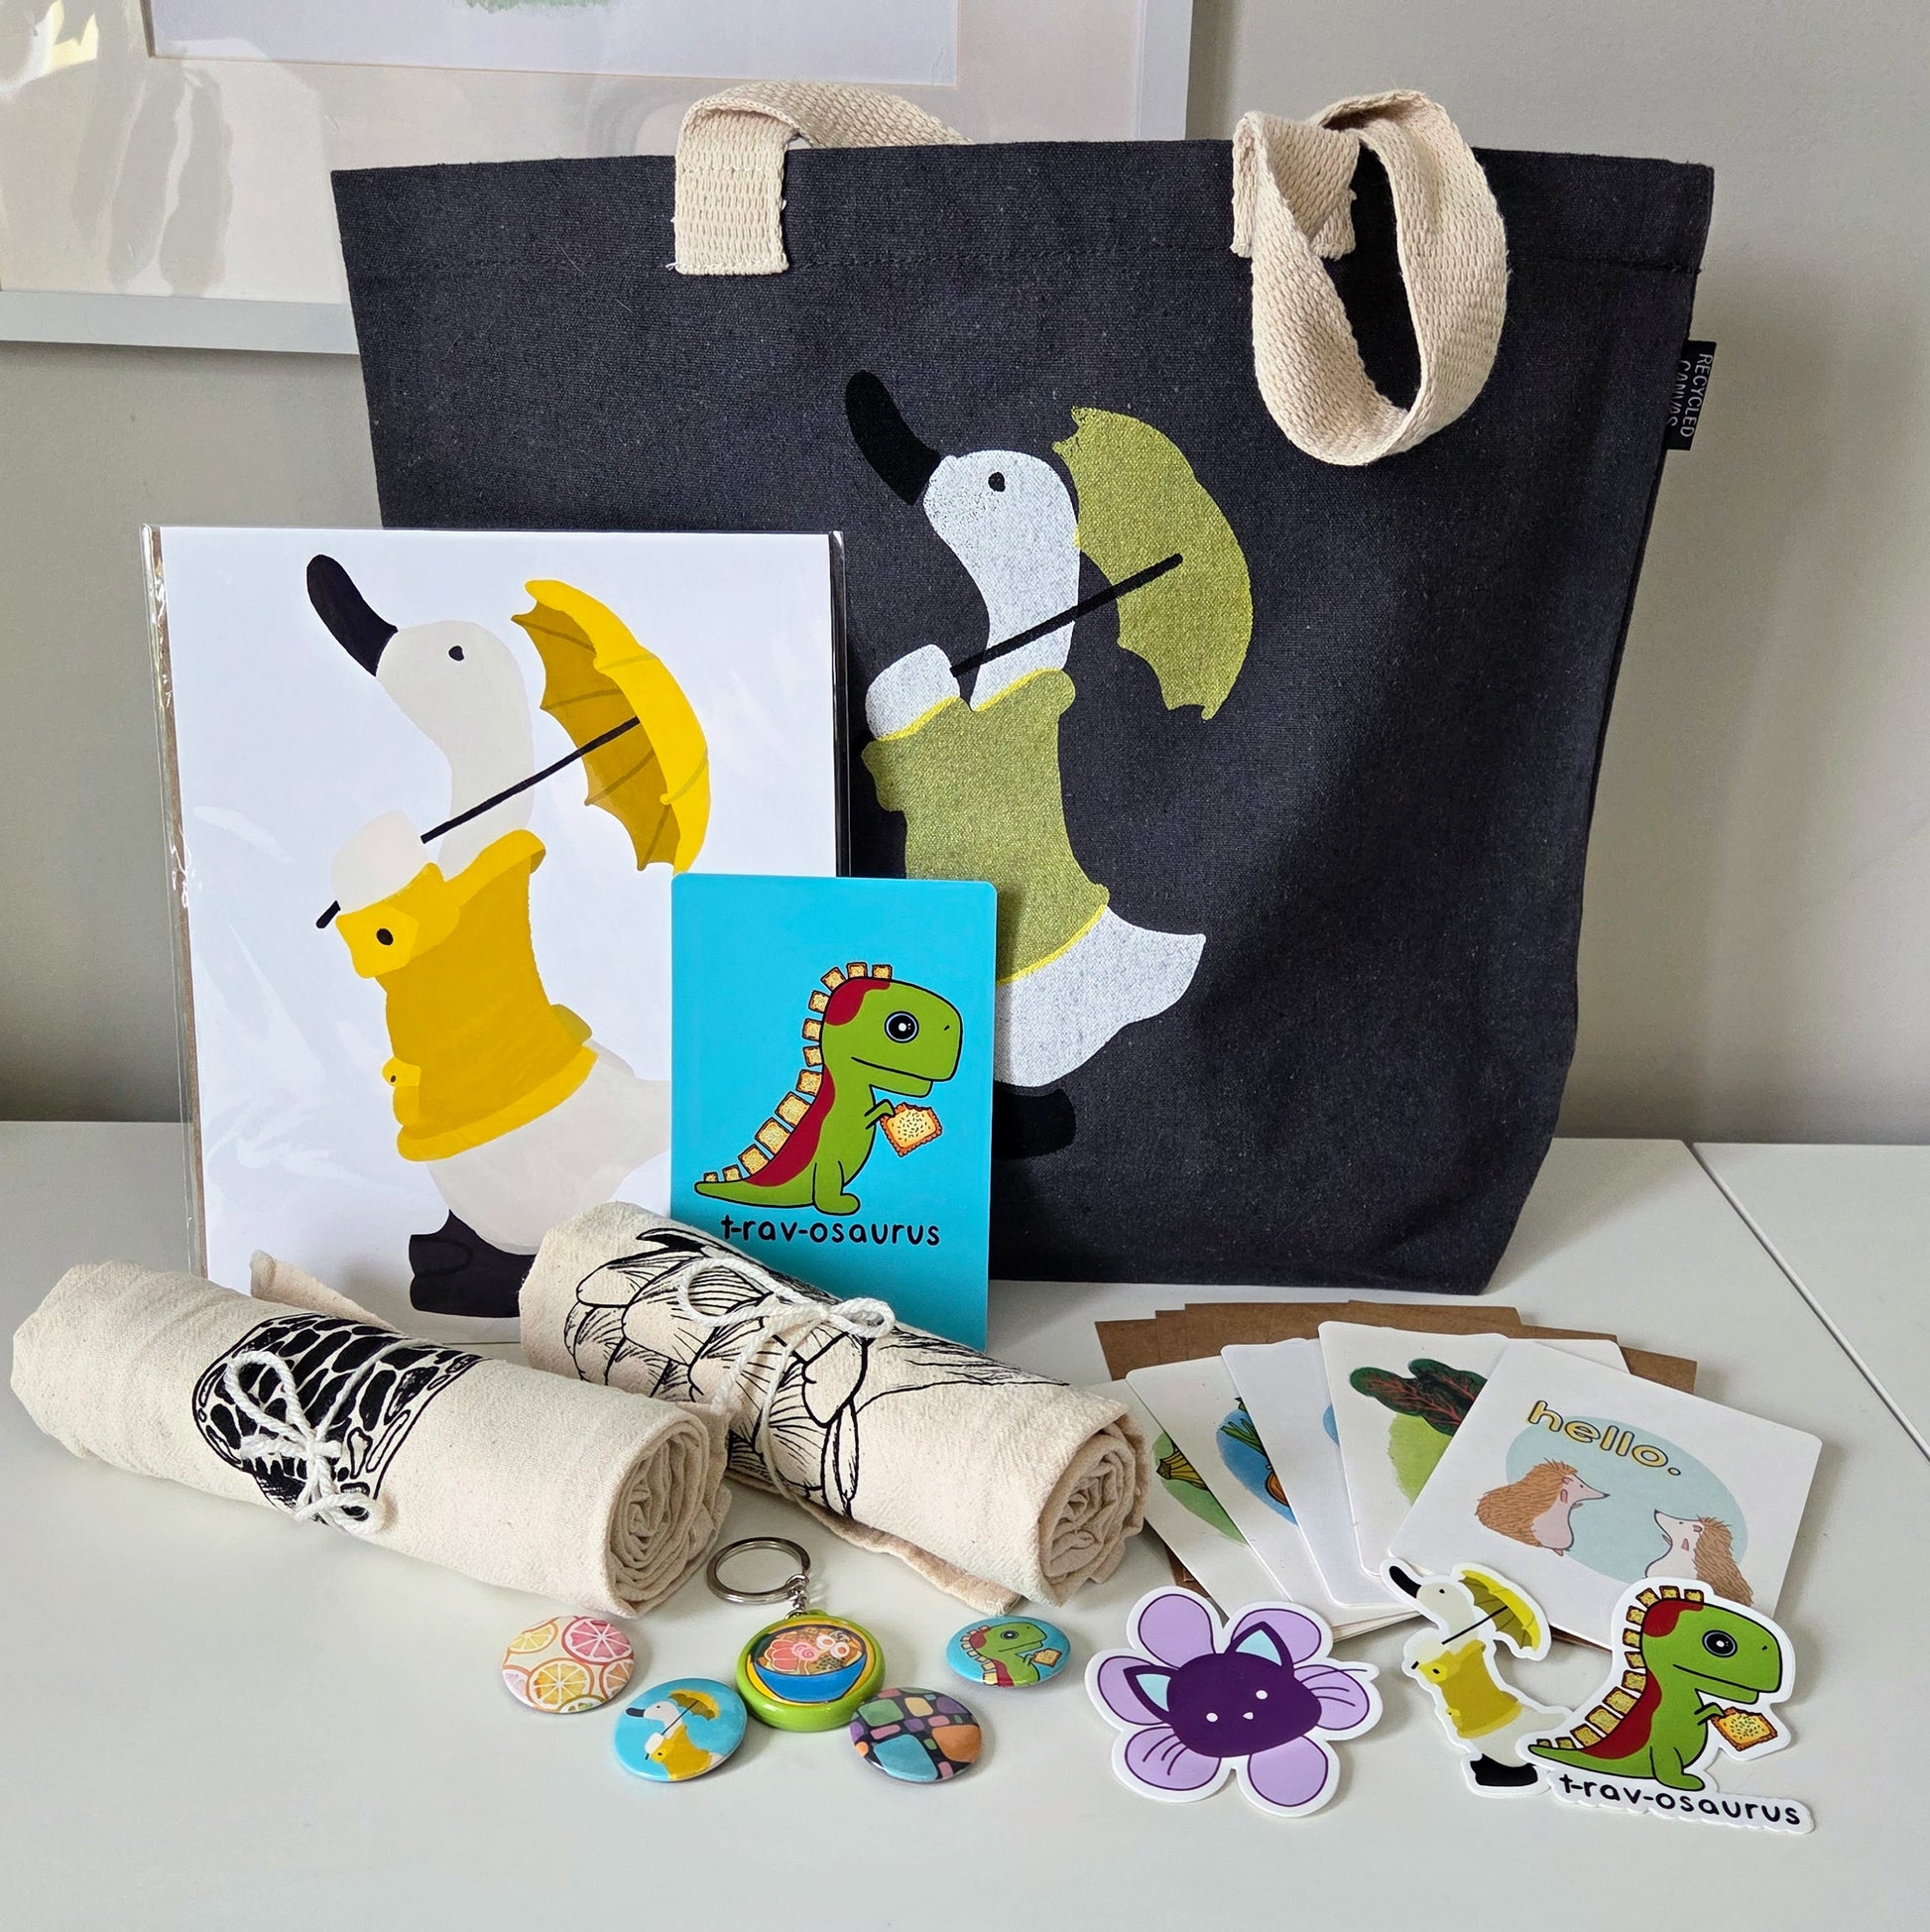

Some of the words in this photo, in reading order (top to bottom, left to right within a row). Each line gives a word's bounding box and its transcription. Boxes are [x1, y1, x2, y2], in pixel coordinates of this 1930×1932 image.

[1680, 353, 1713, 437] RECYCLED
[721, 1214, 940, 1246] t-rav-osaurus
[1527, 1399, 1682, 1477] hello.
[1559, 1773, 1801, 1826] t-rav-osaurus
